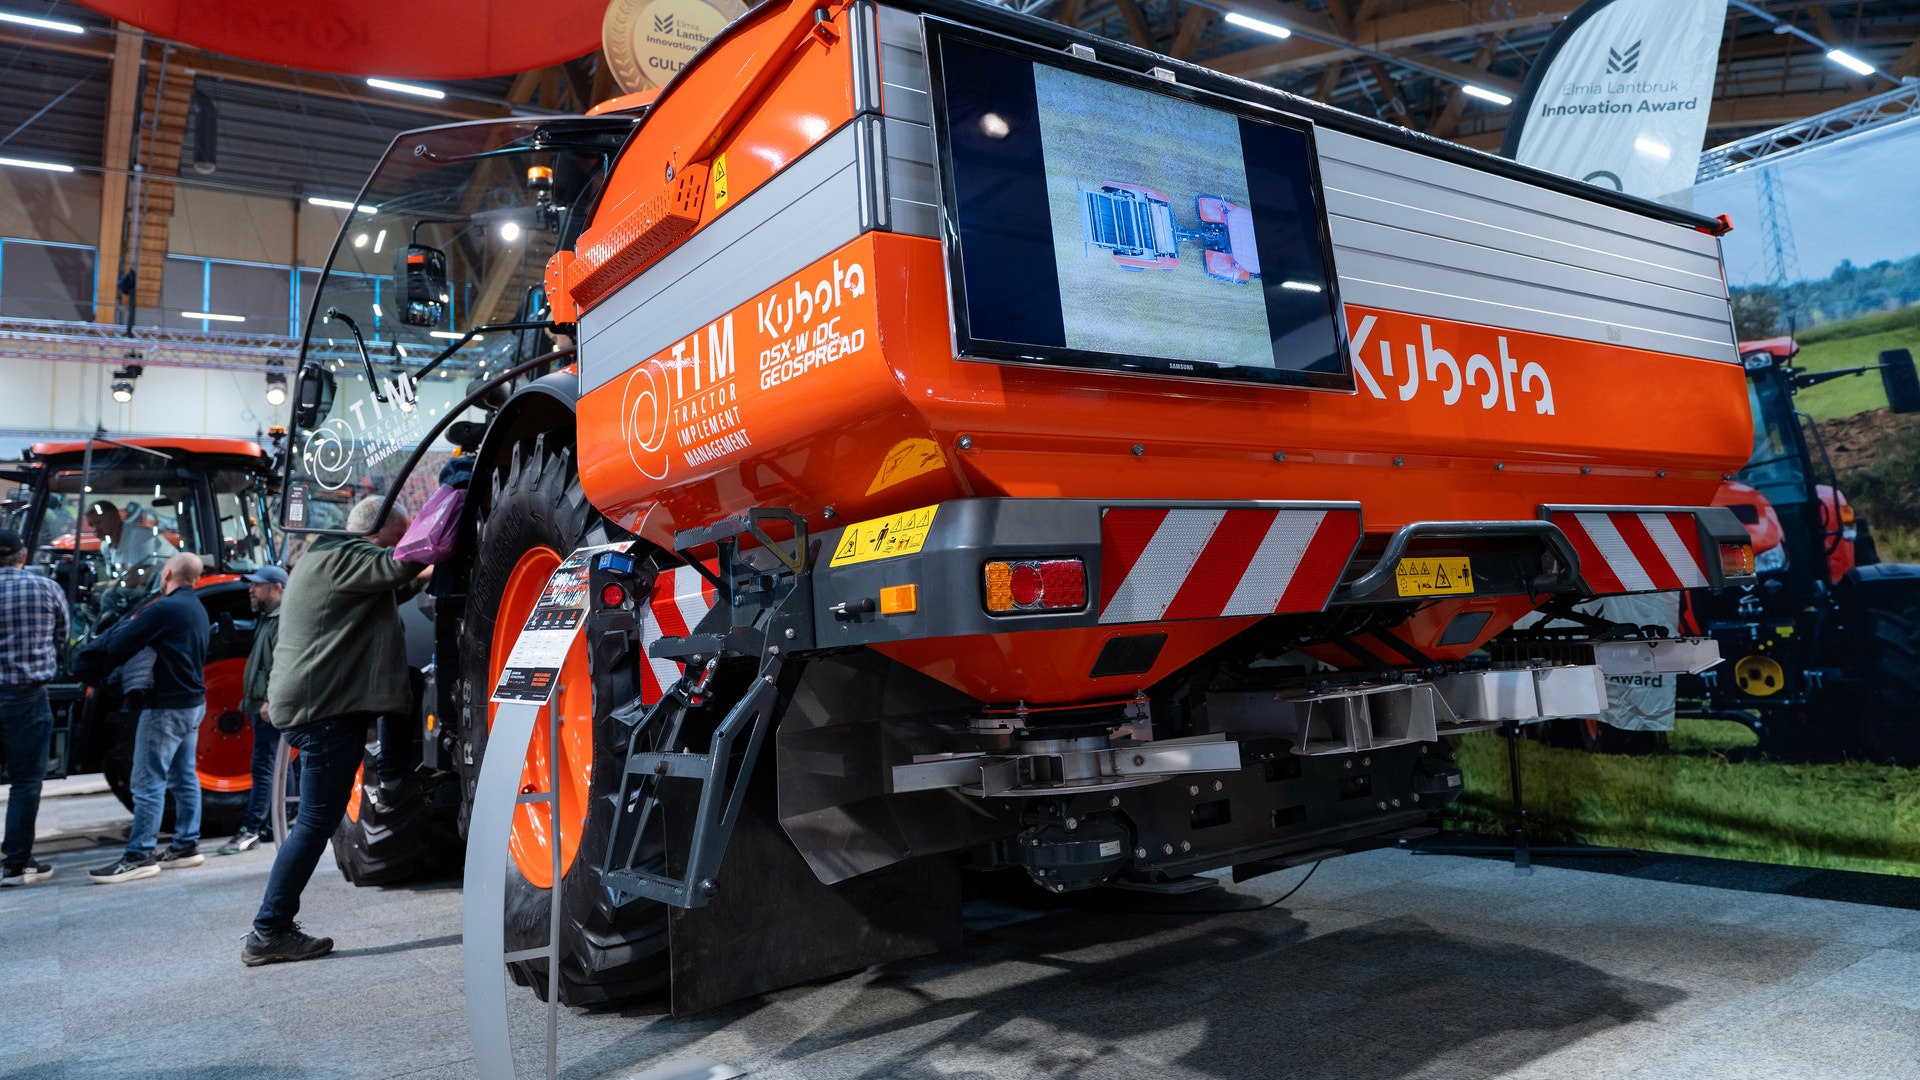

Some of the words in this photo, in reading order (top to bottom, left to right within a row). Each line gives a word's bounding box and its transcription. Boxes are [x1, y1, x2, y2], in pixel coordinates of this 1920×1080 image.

[646, 35, 698, 52] Innovation
[676, 20, 699, 32] Elmia
[1541, 100, 1632, 118] Innovation
[1637, 97, 1698, 113] Award
[1562, 82, 1602, 97] Elmia
[1607, 80, 1679, 95] Lantbruk
[757, 258, 866, 339] Kubota
[671, 313, 736, 400] TIM
[760, 330, 810, 371] DSX-W
[760, 328, 865, 391] GEOSPREAD
[1169, 362, 1194, 371] SAMSUNG
[1350, 315, 1556, 416] Kubota
[349, 371, 414, 432] TIM
[674, 382, 737, 427] TRACTOR
[362, 414, 421, 457] IMPLEMENT
[366, 425, 425, 468] MANAGEMENT
[676, 405, 742, 449] IMPLEMENT
[683, 428, 752, 468] MANAGEMENT
